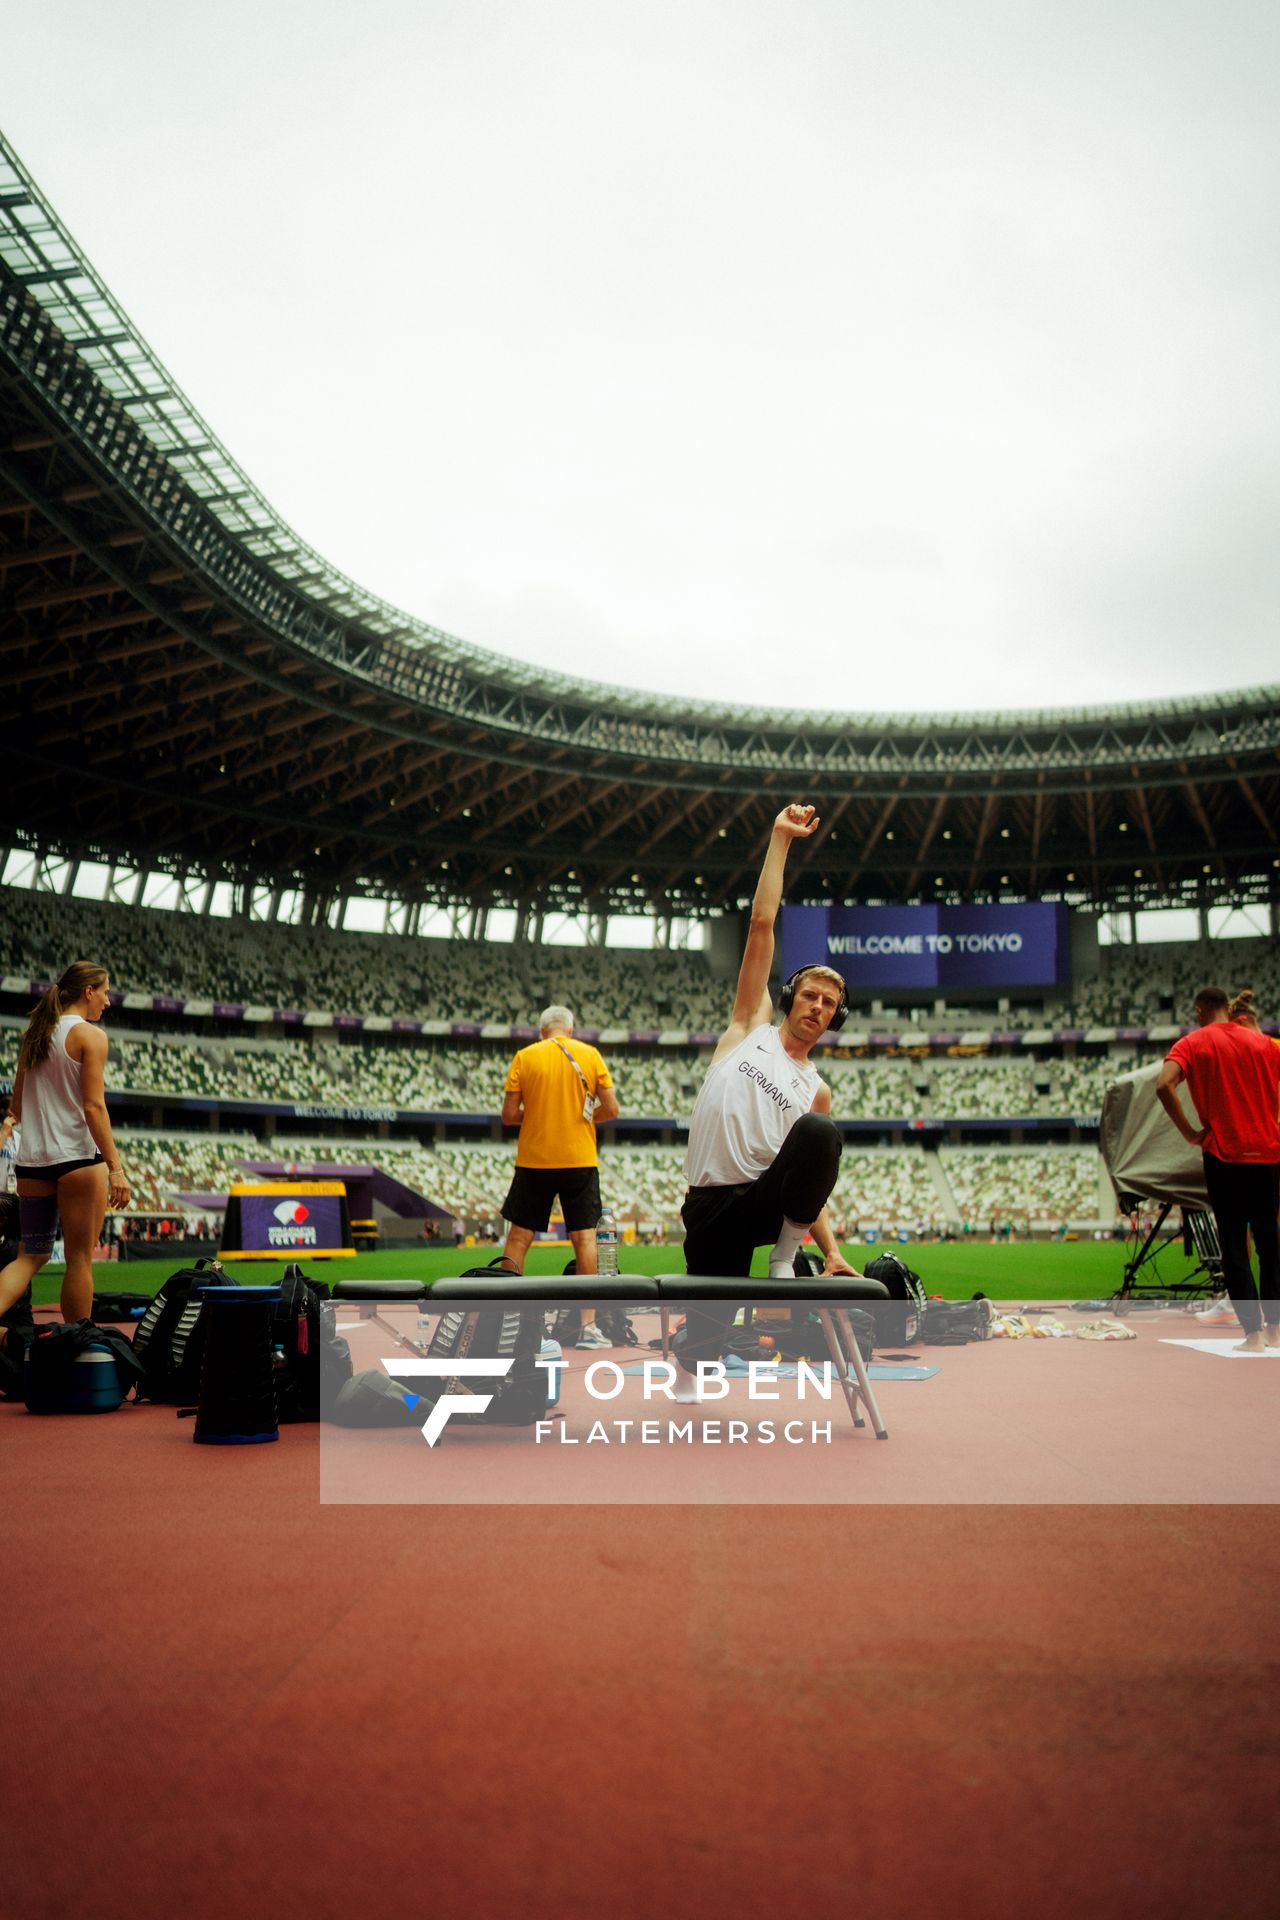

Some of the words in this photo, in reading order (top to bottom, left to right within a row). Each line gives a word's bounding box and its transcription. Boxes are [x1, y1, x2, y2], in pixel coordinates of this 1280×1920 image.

[827, 935, 923, 954] WELCOME
[925, 934, 953, 953] TO
[956, 933, 1023, 953] TOKYO
[738, 1061, 792, 1111] GERMANY
